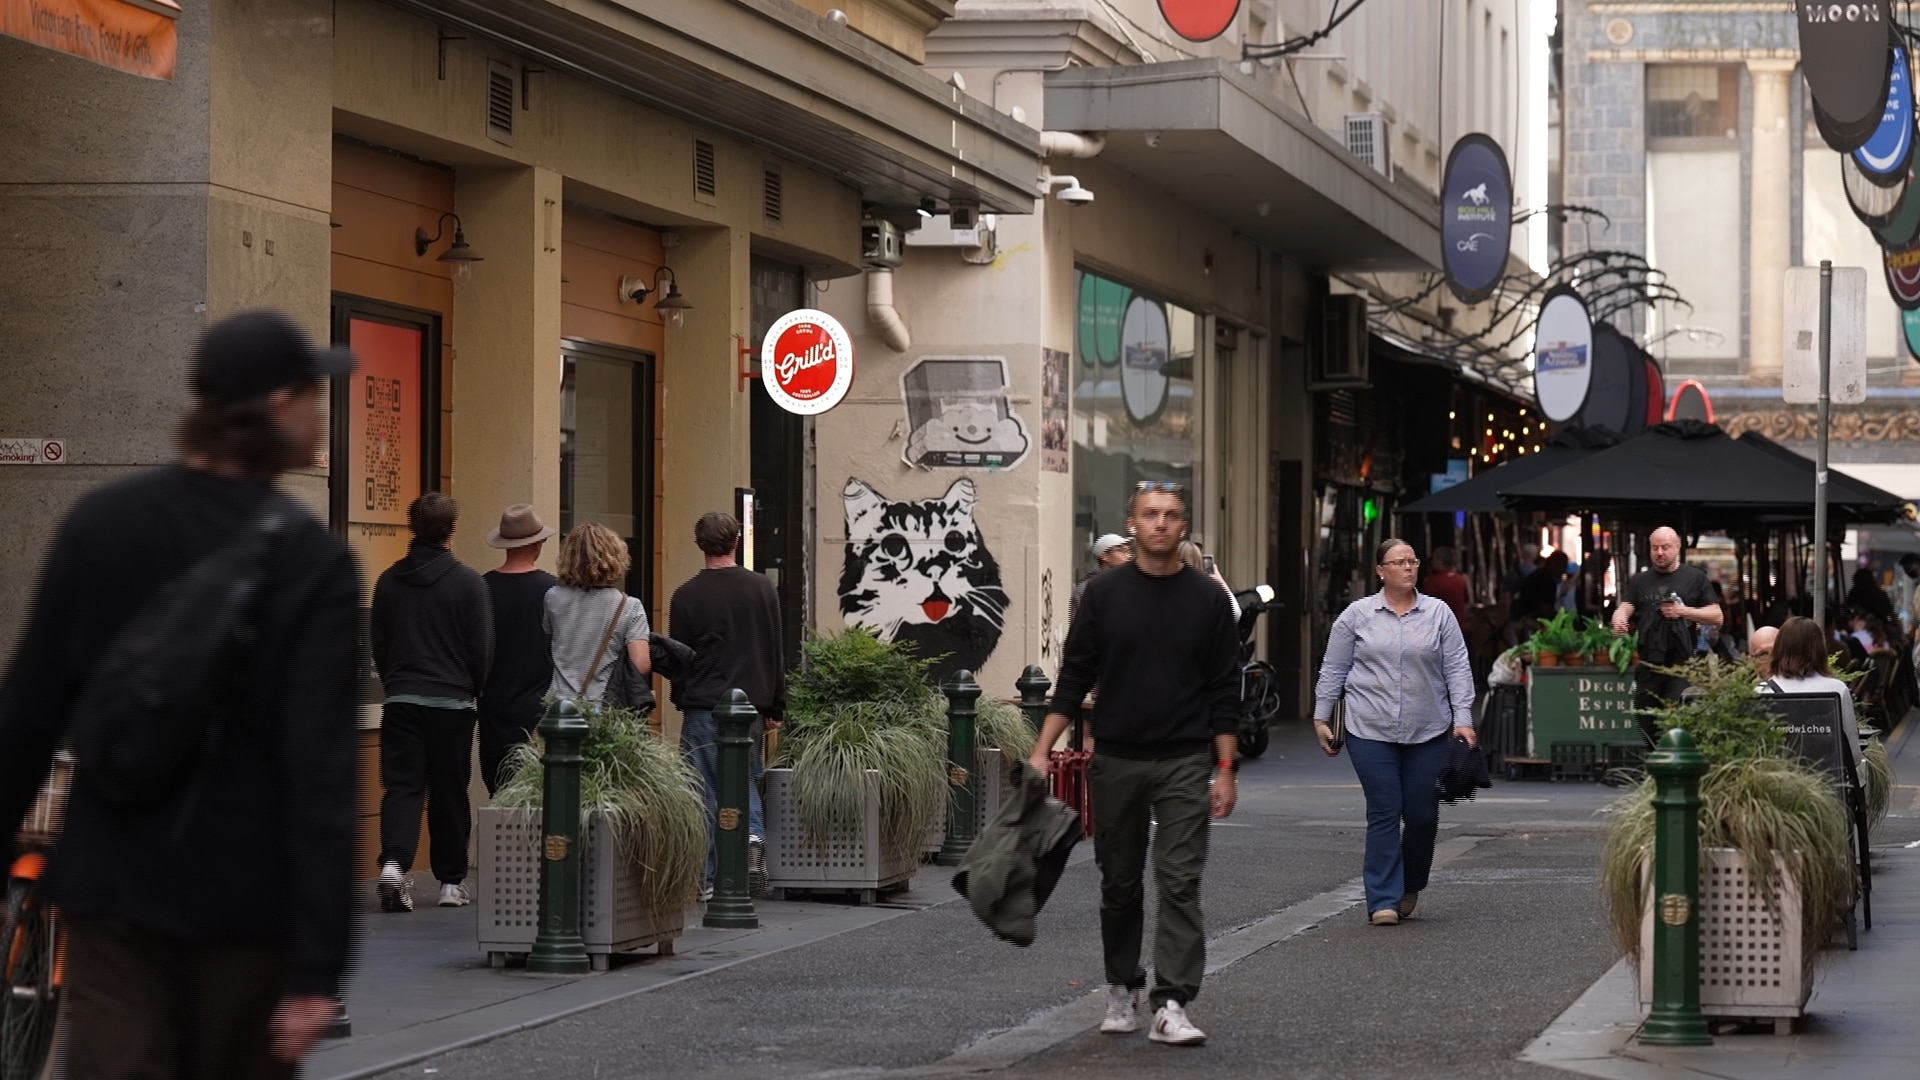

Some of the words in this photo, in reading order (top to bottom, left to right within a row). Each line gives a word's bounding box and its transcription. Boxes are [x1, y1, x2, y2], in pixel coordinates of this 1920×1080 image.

[1805, 4, 1880, 22] MOON
[1456, 240, 1478, 252] CAE
[775, 339, 835, 385] Grill'd
